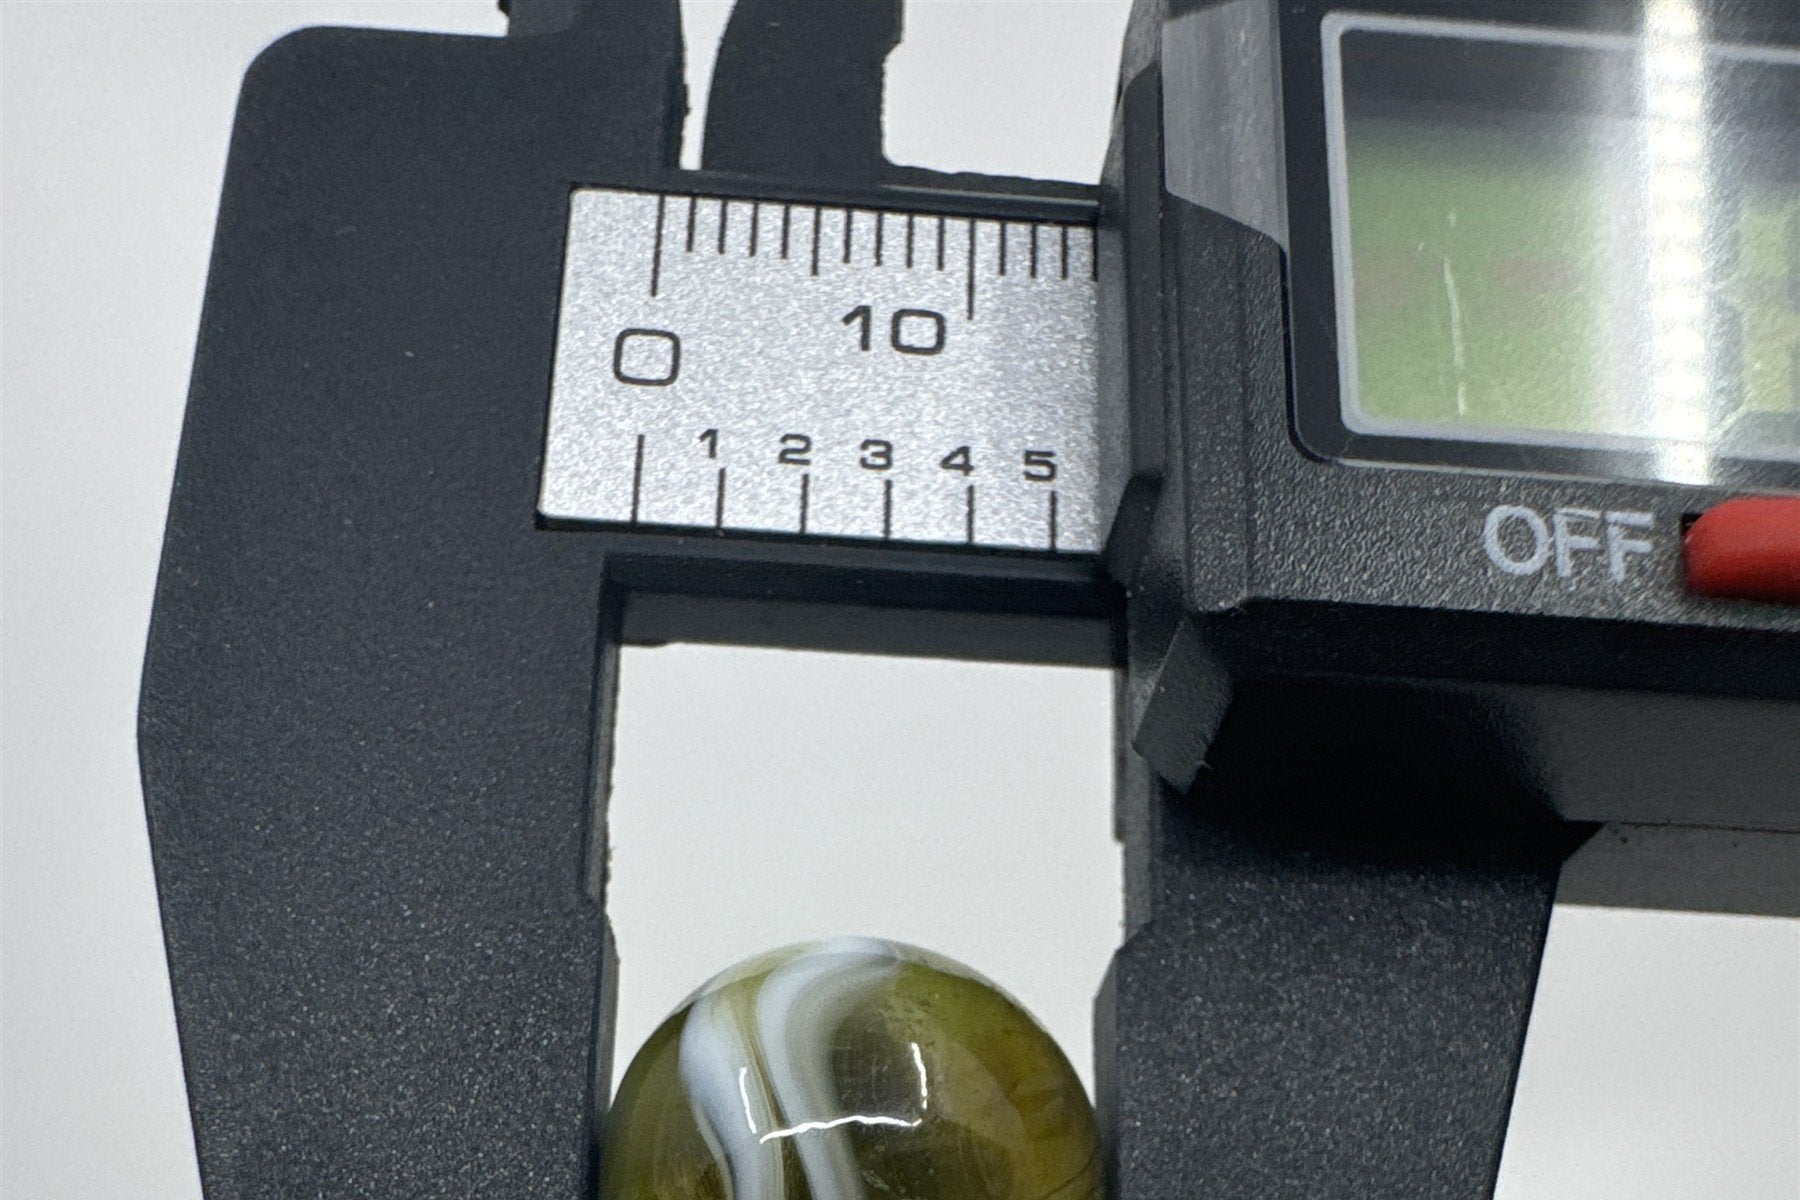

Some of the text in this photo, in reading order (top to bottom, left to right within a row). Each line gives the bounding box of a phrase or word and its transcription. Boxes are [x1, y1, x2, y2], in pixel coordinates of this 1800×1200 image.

[613, 305, 946, 386] 0 10
[699, 429, 1056, 482] 1 2 3 4 5
[1483, 504, 1655, 582] OFF
